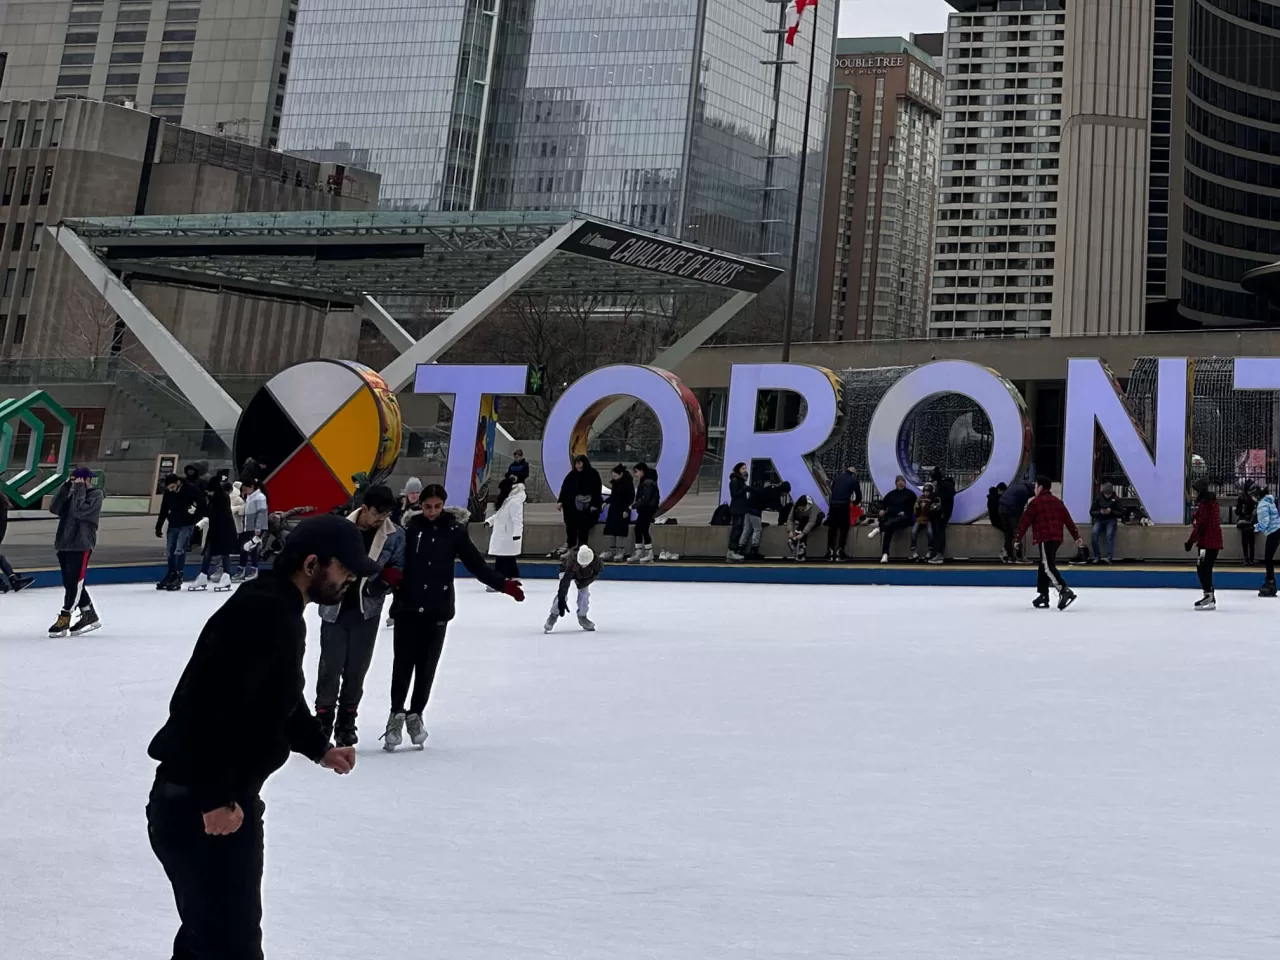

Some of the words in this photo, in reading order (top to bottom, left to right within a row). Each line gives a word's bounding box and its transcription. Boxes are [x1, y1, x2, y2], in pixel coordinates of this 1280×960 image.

[610, 238, 695, 273] CAVALCADE
[678, 254, 710, 276] OF
[693, 258, 745, 285] LIGHTS
